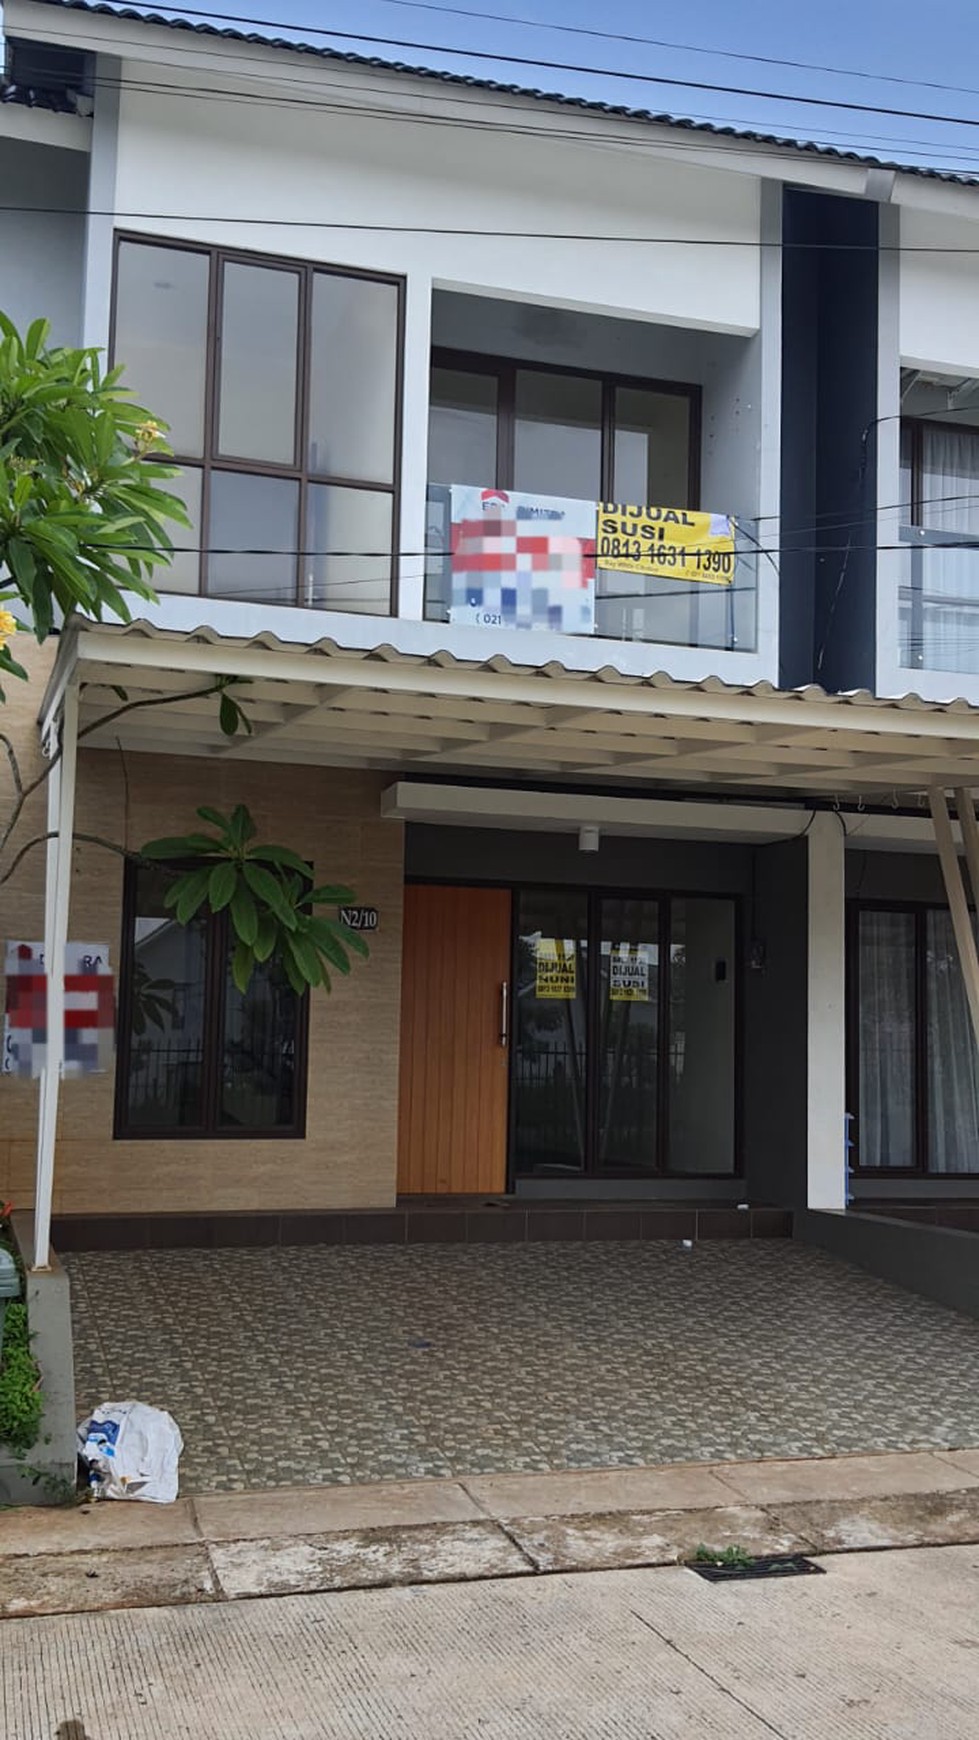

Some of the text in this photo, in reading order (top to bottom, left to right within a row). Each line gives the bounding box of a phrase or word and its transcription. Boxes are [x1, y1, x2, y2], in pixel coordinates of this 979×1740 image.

[602, 502, 695, 526] DIJUAL
[602, 519, 665, 541] SUSI
[601, 536, 731, 574] 0813 1631 1390
[341, 909, 377, 927] N2/10
[539, 962, 575, 974] DIJUAL
[612, 965, 647, 977] DIJUAL
